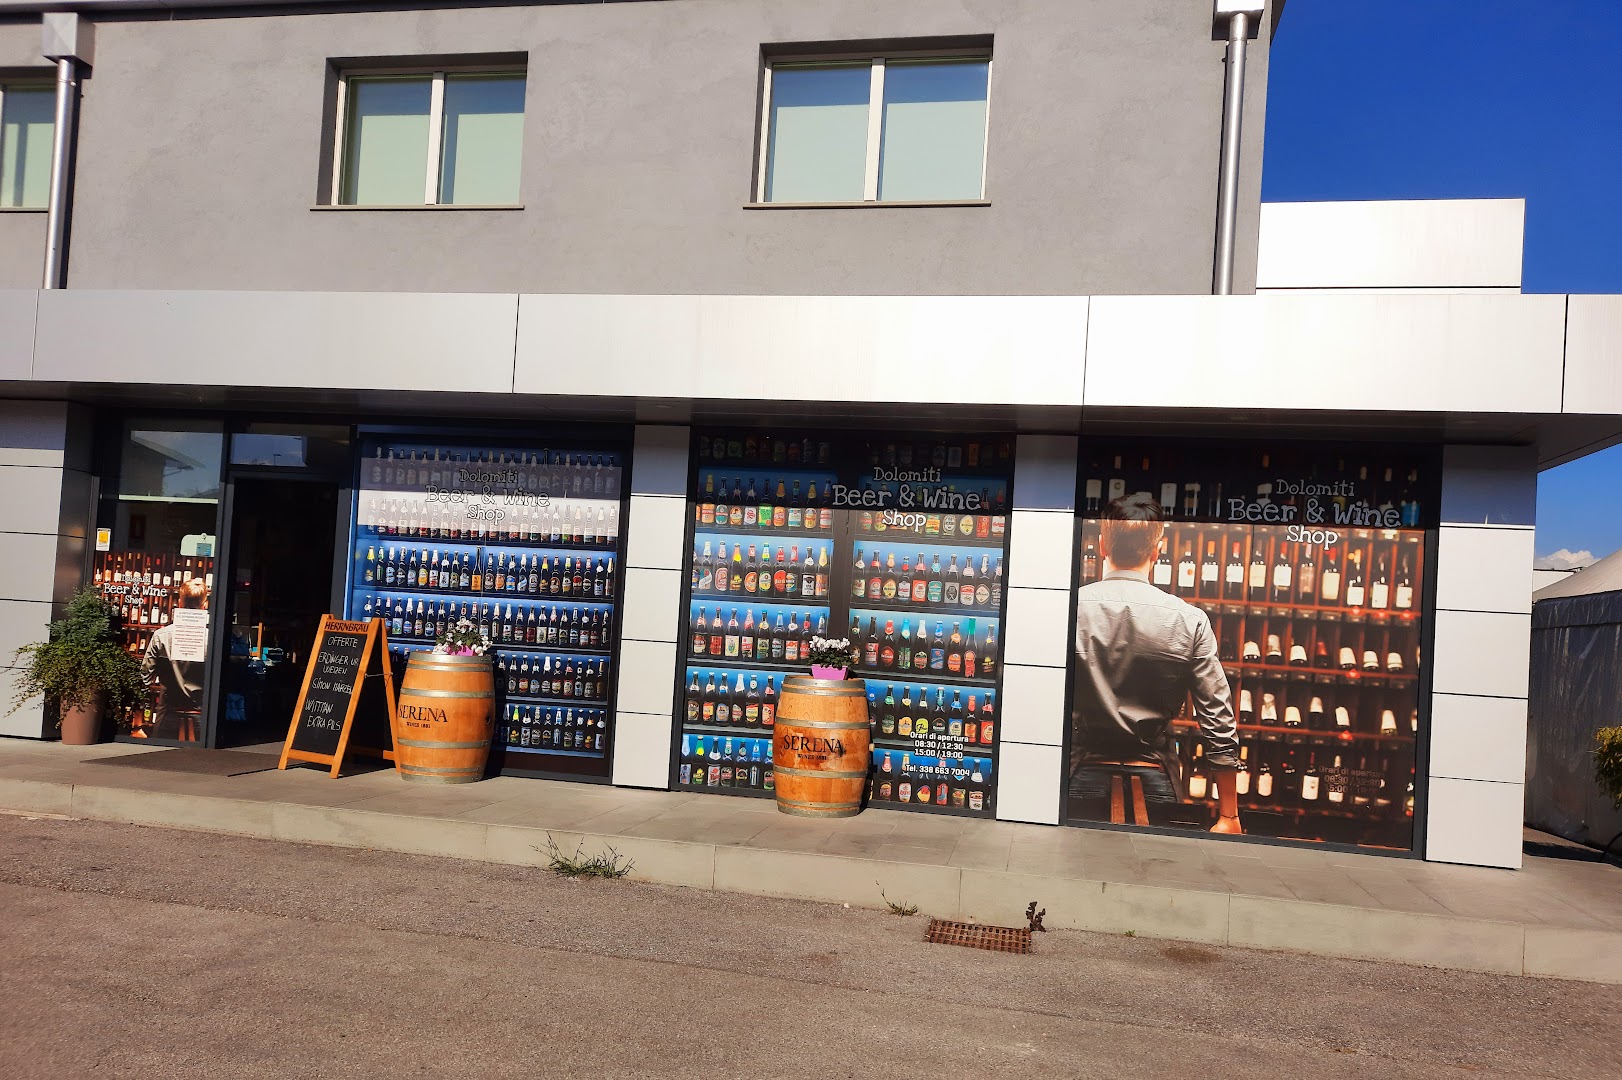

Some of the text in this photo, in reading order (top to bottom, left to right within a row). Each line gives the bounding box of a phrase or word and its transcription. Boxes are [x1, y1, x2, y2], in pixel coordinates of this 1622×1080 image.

[460, 468, 518, 483] Dolomiti
[874, 466, 941, 483] Dolomiti
[425, 485, 550, 507] Beer & Wine
[1276, 479, 1355, 497] Dolomiti
[832, 484, 981, 510] Beer & Wine
[467, 504, 505, 526] Shop
[882, 508, 926, 532] Shop
[1228, 498, 1402, 528] Beer & Wine
[1286, 524, 1339, 550] Shop
[104, 583, 168, 597] Beer & Wine
[125, 595, 144, 607] Shop
[327, 636, 358, 648] OFFERTE
[399, 704, 448, 722] SERENA
[783, 734, 843, 754] SERENA
[910, 731, 969, 743] Orari di apertura
[914, 740, 964, 751] 08:30 / 12:30
[914, 749, 963, 759] 15:00 / 19:00
[906, 765, 918, 773] Tel.
[935, 767, 949, 775] 663
[951, 768, 970, 776] 7004
